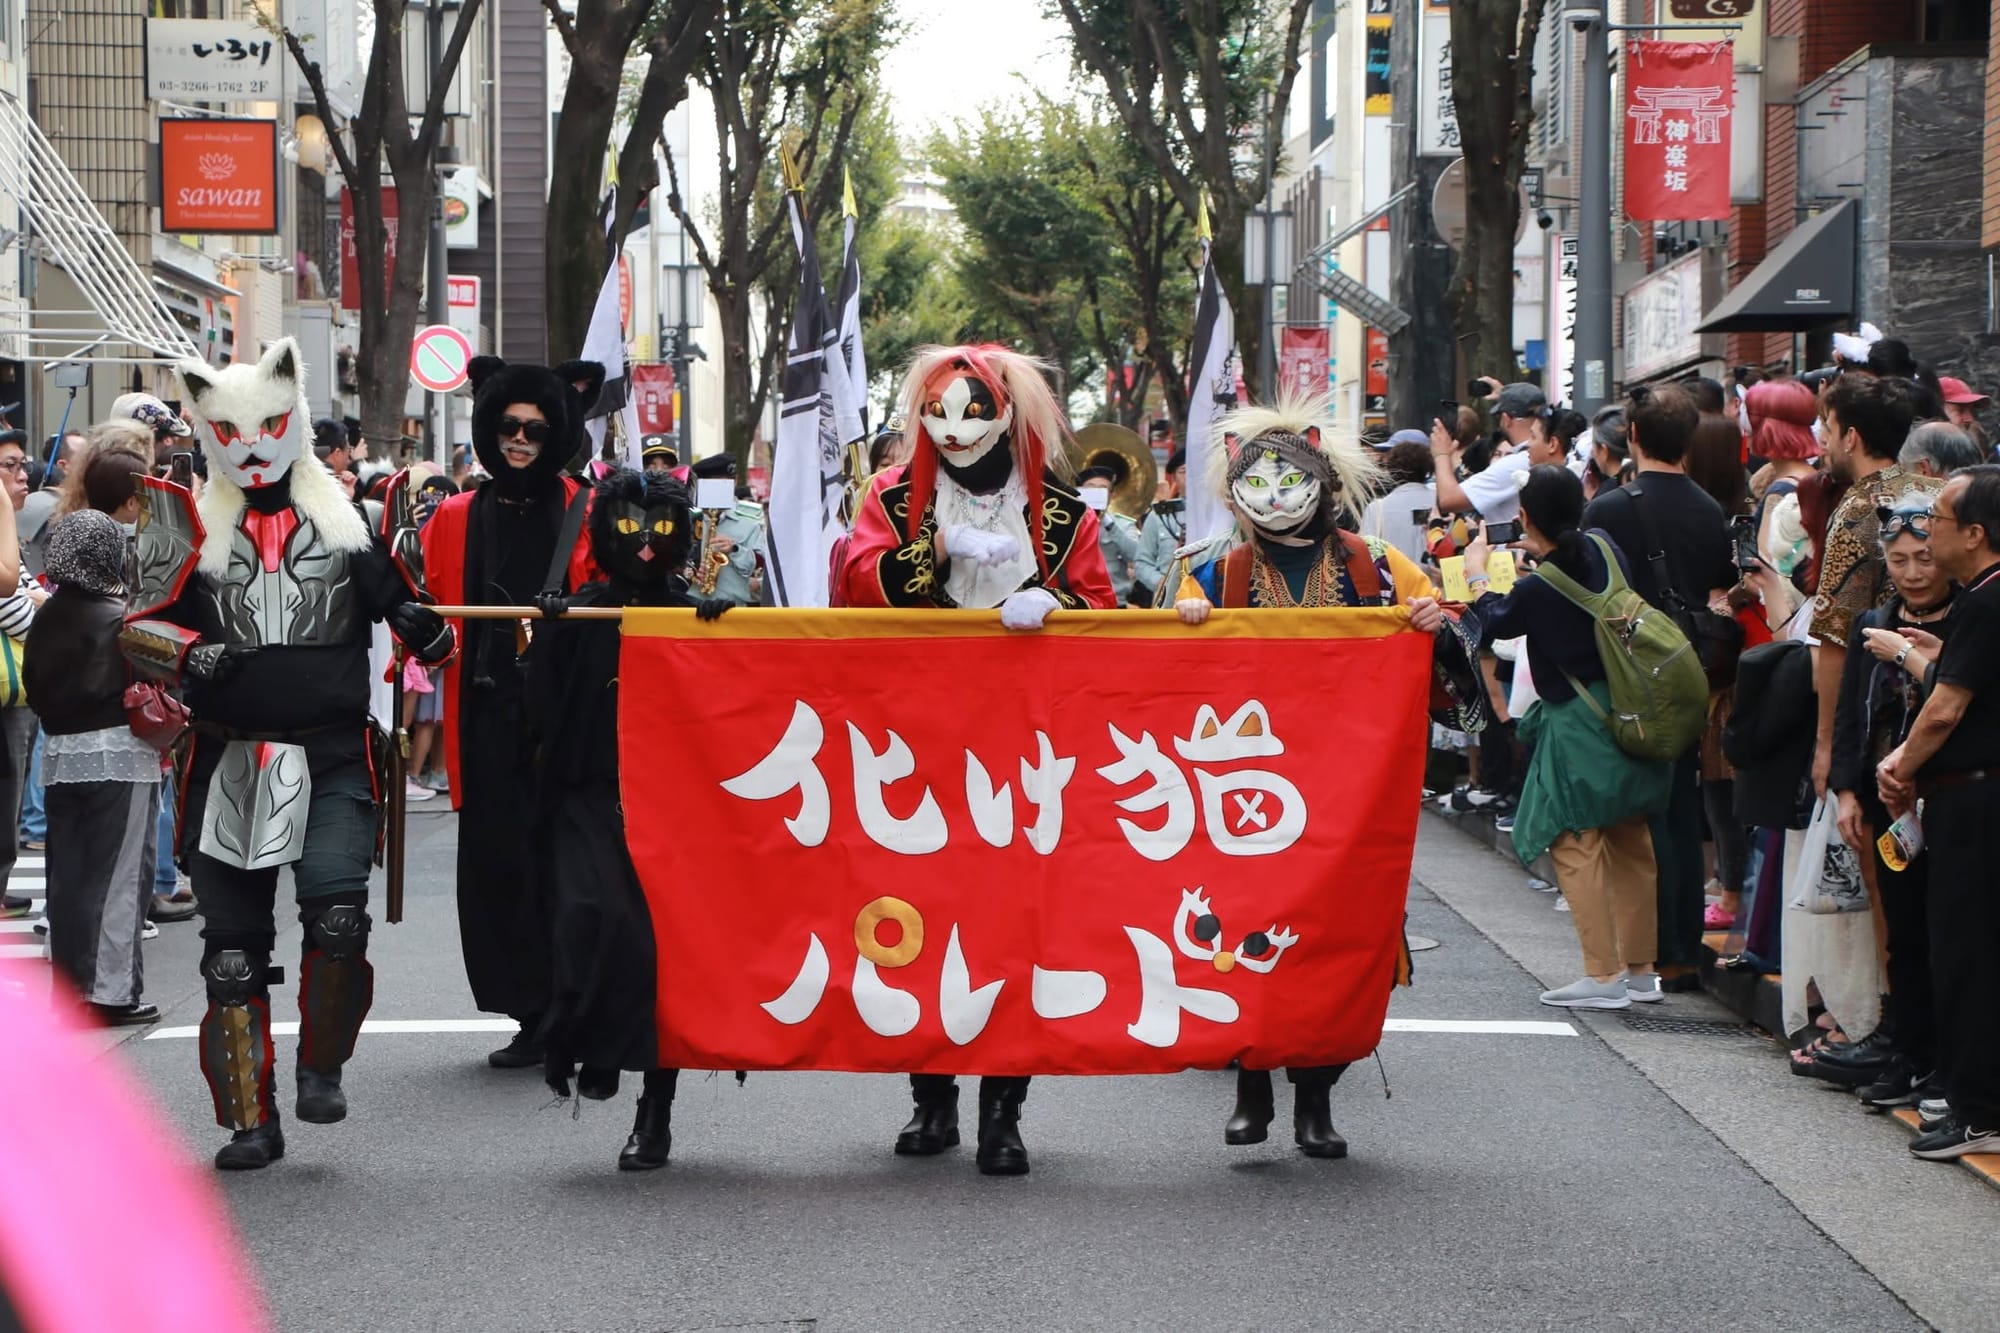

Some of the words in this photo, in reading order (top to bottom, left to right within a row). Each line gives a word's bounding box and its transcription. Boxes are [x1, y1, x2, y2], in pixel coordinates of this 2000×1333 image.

[192, 39, 271, 66] いろり
[159, 81, 243, 93] 03-3266-1762
[250, 80, 269, 93] 2F
[1664, 118, 1689, 191] 神楽坂
[177, 187, 261, 207] sawan
[719, 699, 1308, 862] 化け猫
[759, 885, 1300, 1047] パレード
